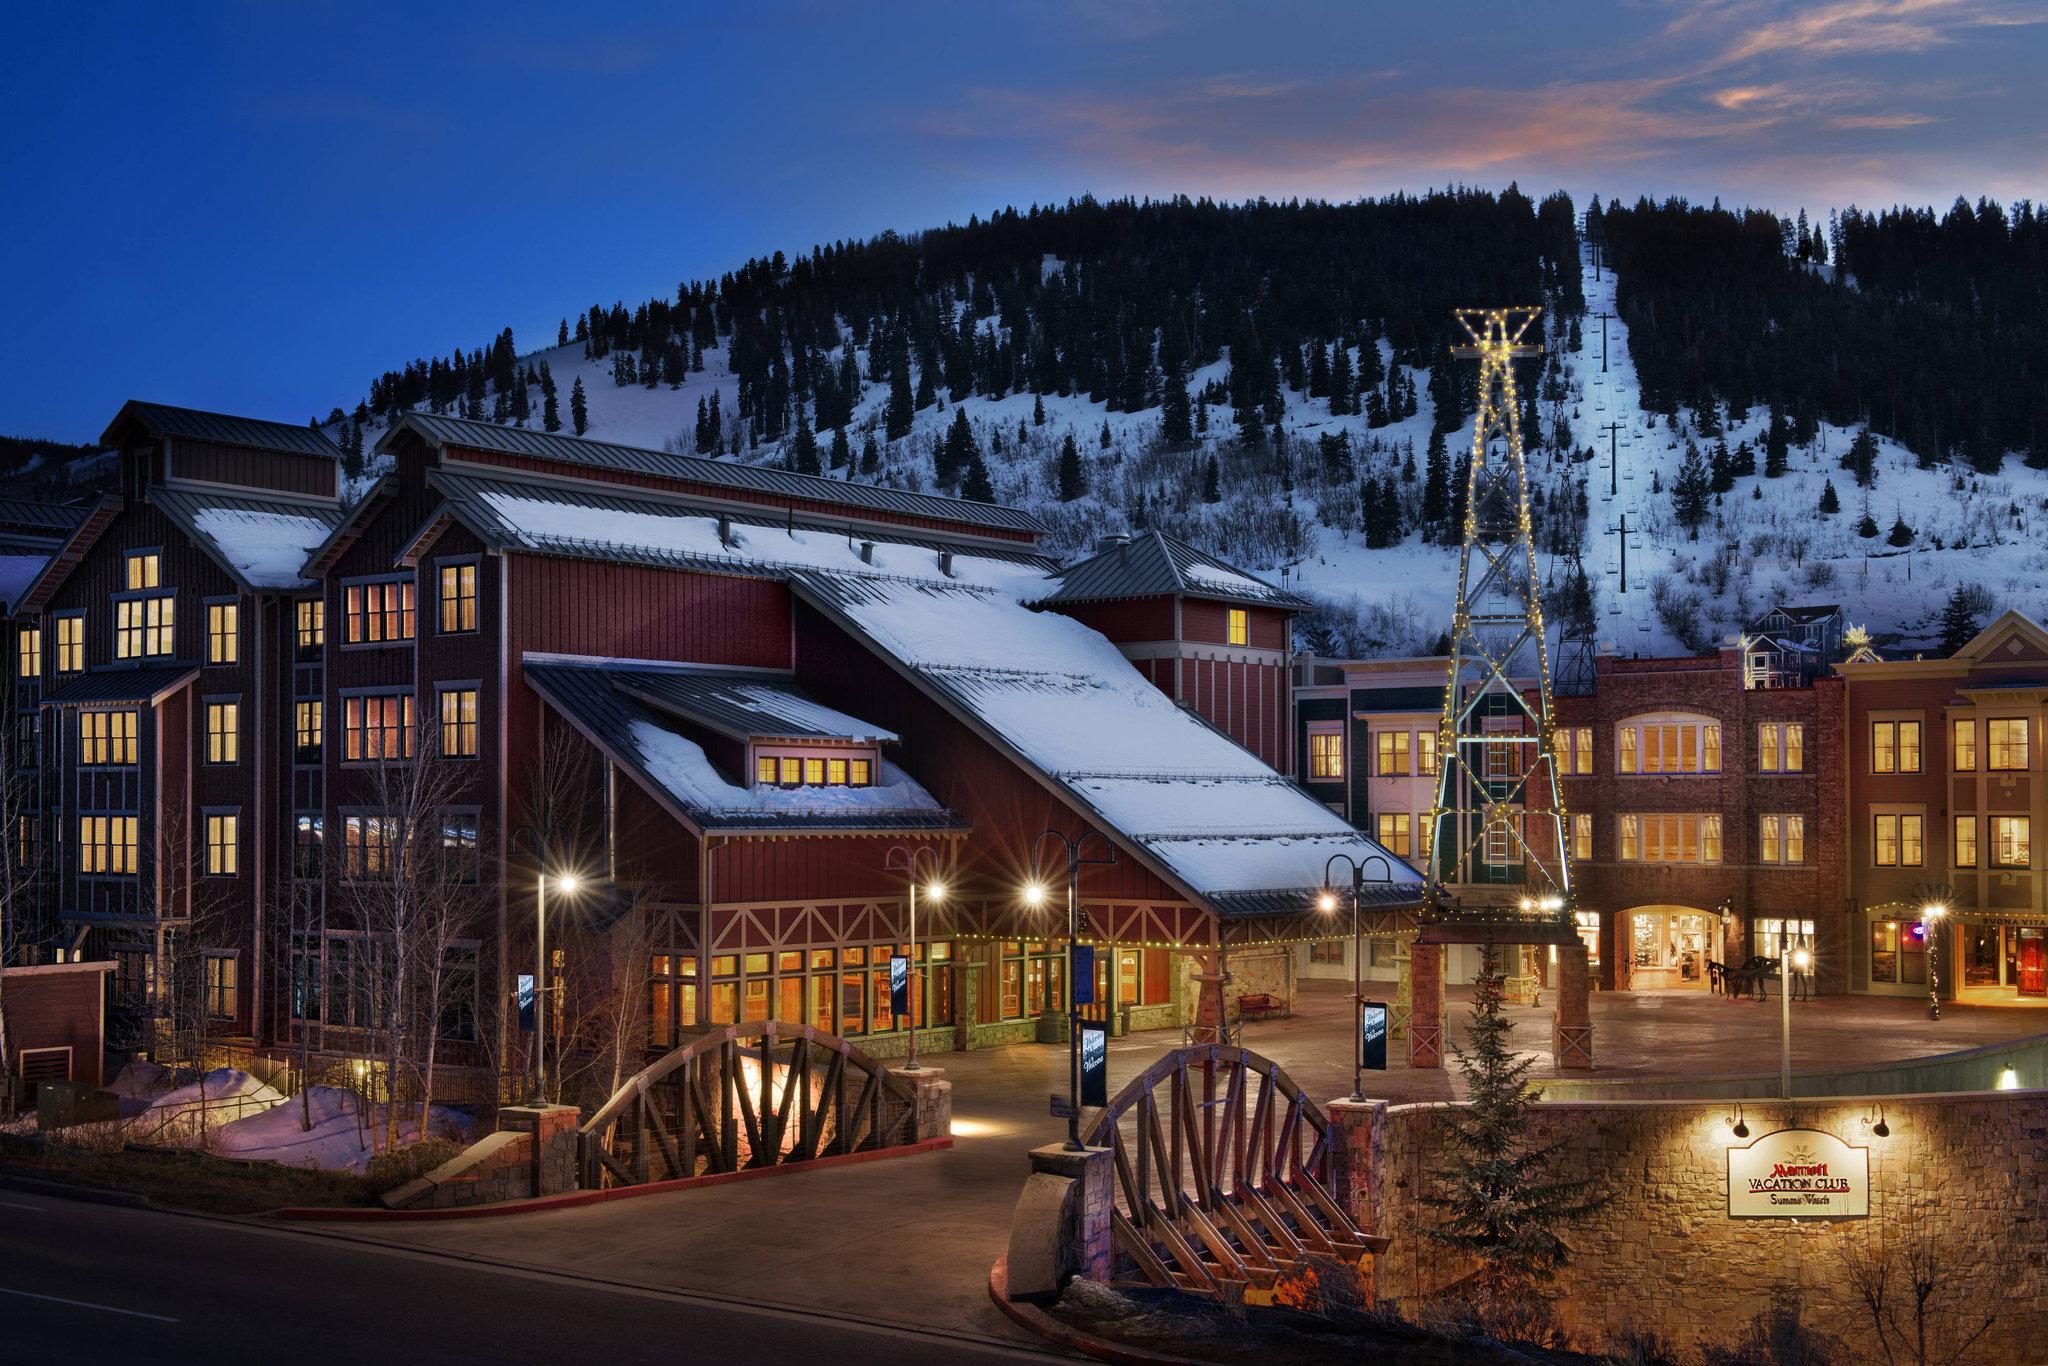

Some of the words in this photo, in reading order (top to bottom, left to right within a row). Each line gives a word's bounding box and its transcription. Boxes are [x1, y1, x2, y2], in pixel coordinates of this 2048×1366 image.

[2022, 919, 2046, 927] VITA
[1769, 1163, 1829, 1179] Marriott
[1748, 1178, 1812, 1190] VACATION
[1815, 1178, 1848, 1190] CLUB
[1770, 1193, 1804, 1205] Summi
